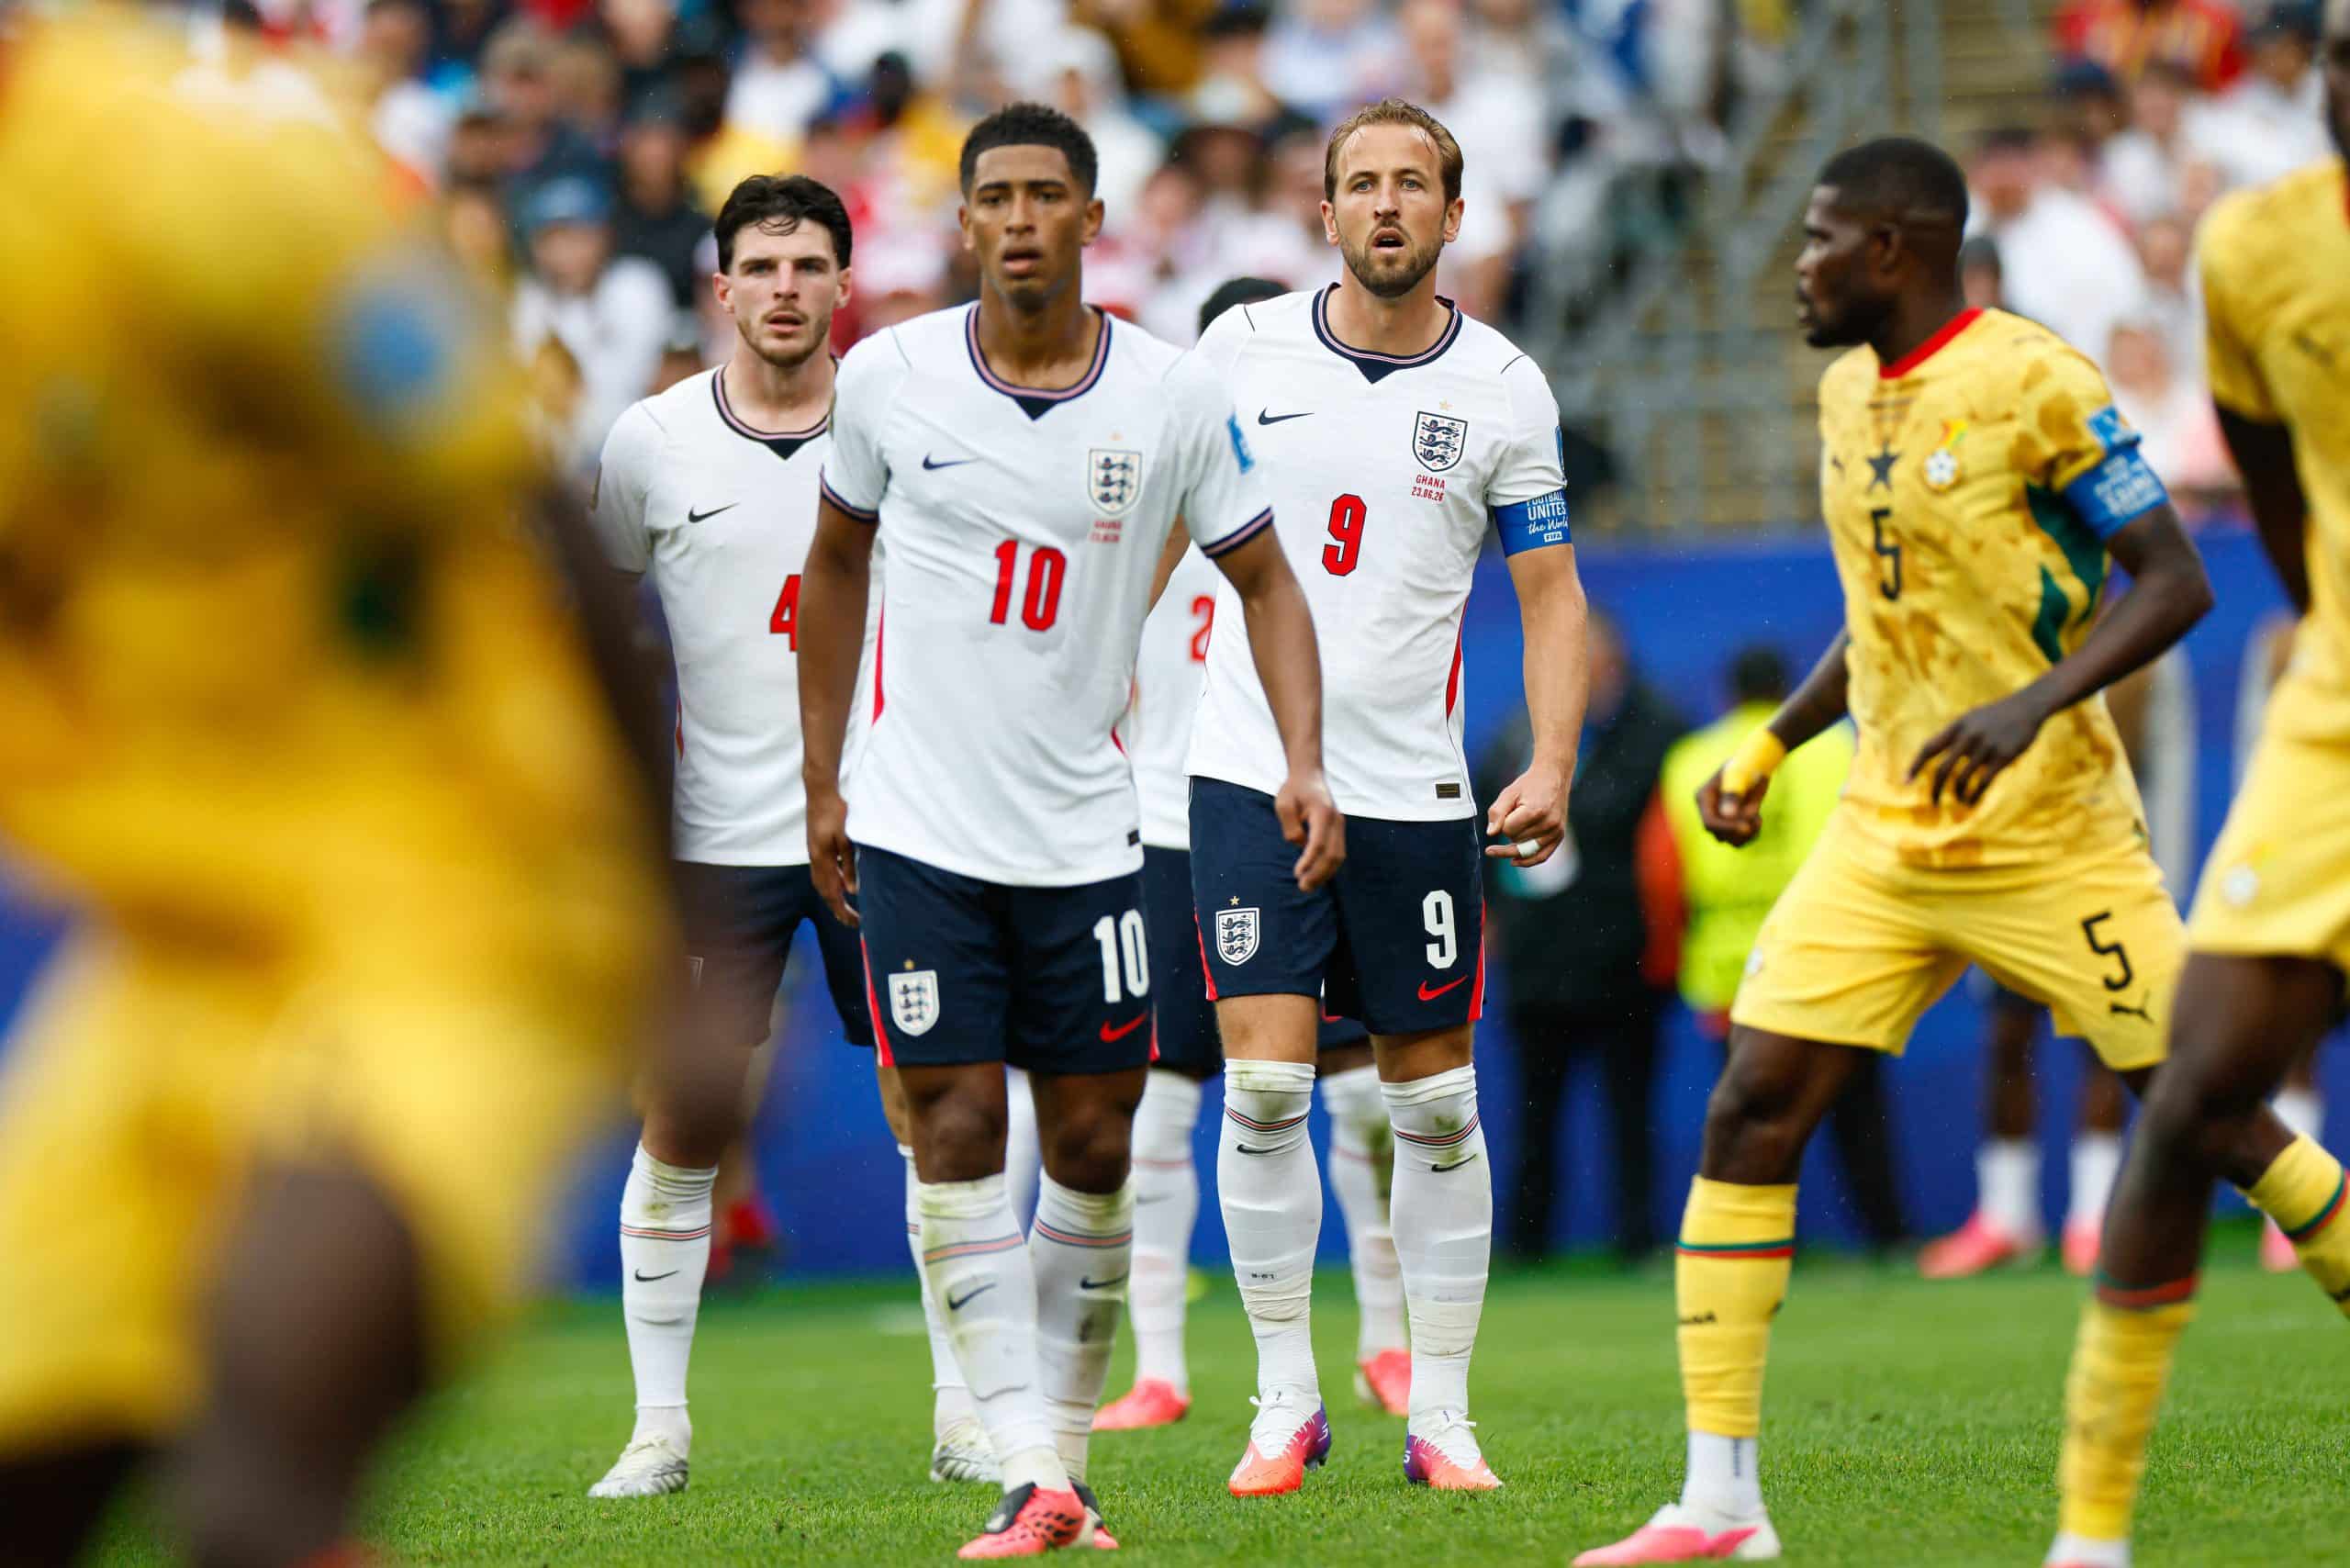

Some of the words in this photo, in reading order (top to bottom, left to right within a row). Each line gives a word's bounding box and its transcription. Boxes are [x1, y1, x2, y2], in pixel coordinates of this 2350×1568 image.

[1415, 474, 1446, 490] GHANA
[1528, 501, 1567, 521] UNITES
[1323, 494, 1366, 576] 9
[1528, 521, 1547, 535] the
[1871, 506, 1901, 601] 5
[769, 574, 802, 652] 4
[991, 540, 1066, 632] 10
[1094, 910, 1149, 1004] 10
[1423, 890, 1457, 969] 9
[2082, 911, 2132, 991] 5
